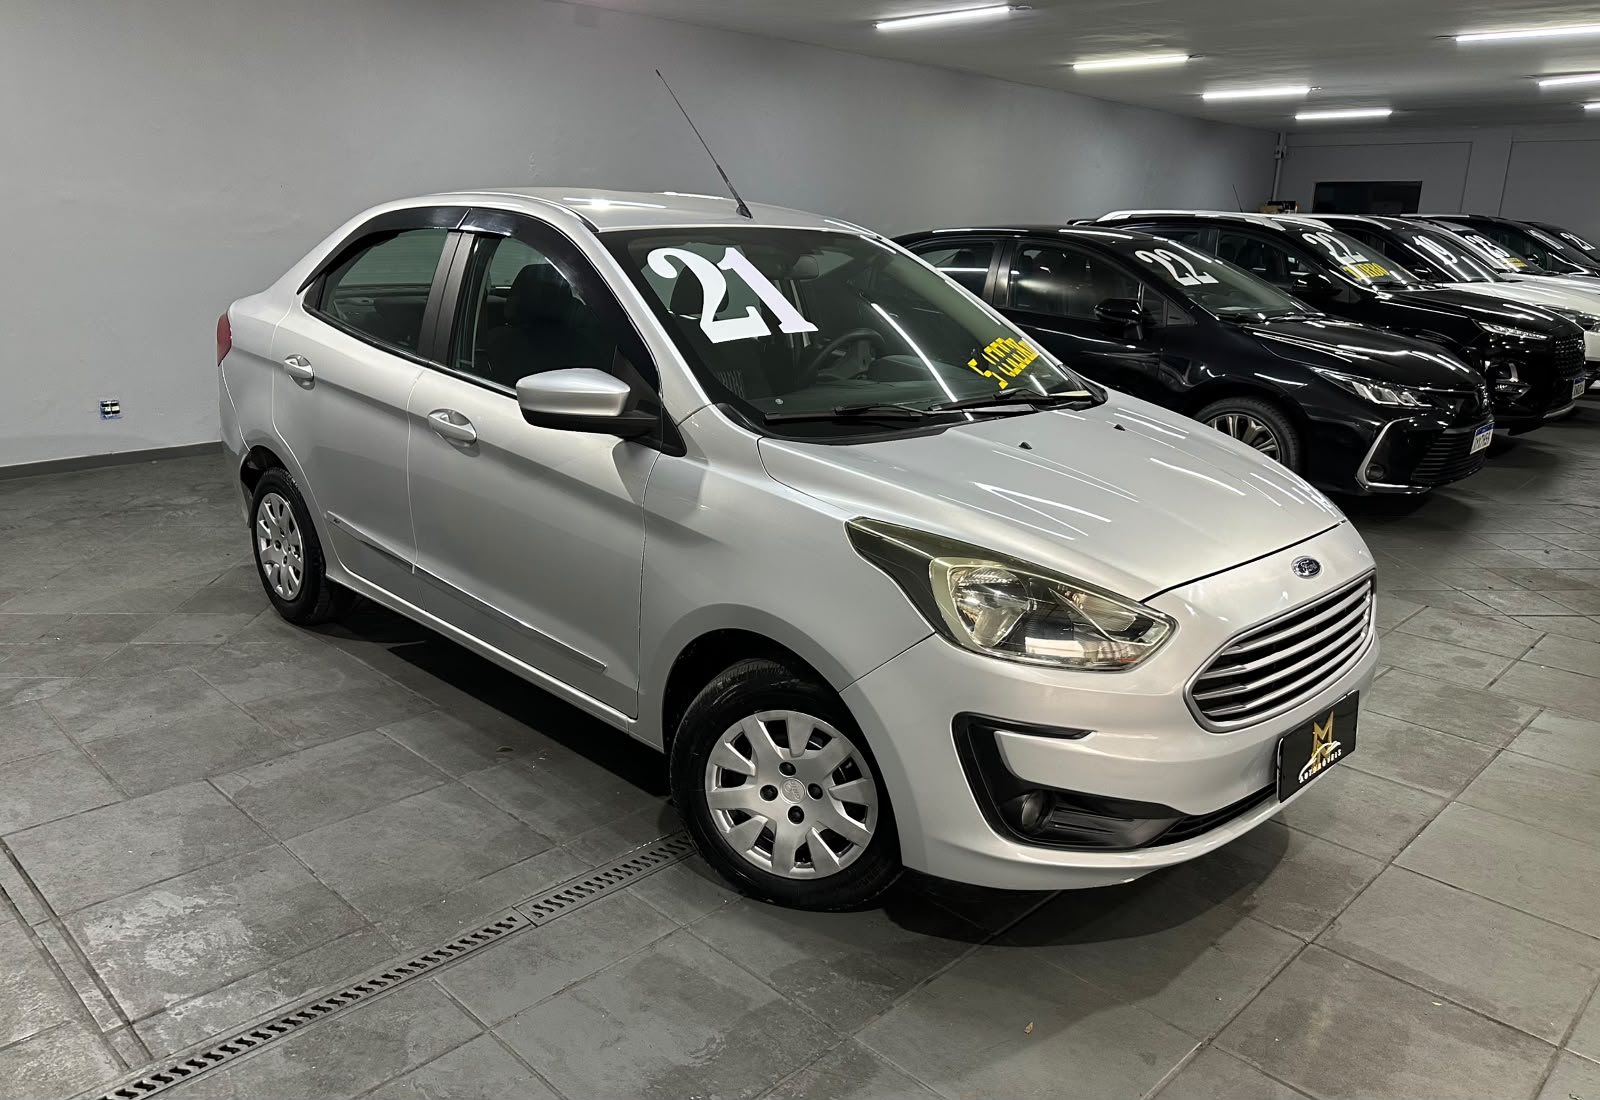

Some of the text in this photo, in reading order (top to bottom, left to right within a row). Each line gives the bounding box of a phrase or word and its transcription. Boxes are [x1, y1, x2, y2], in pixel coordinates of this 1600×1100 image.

[1302, 231, 1369, 265] 22
[1412, 235, 1458, 265] 19
[1134, 248, 1220, 287] 22
[647, 247, 819, 344] 21
